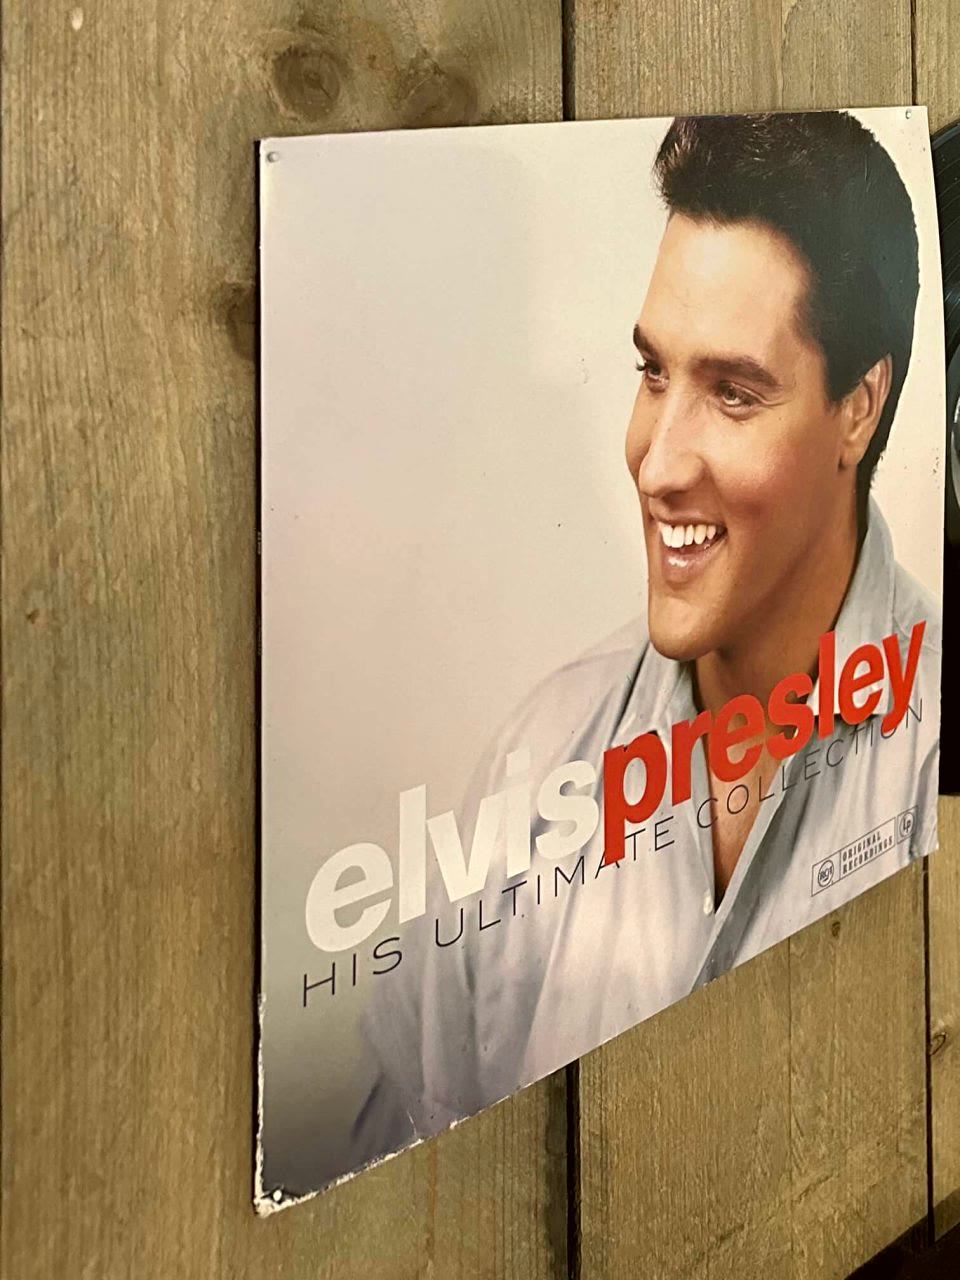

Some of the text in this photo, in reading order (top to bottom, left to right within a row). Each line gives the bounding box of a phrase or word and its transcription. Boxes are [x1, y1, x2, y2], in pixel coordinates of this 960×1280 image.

[842, 831, 881, 862] ORIGINAL
[843, 835, 893, 875] RECORDINGS
[302, 936, 402, 1008] HIS
